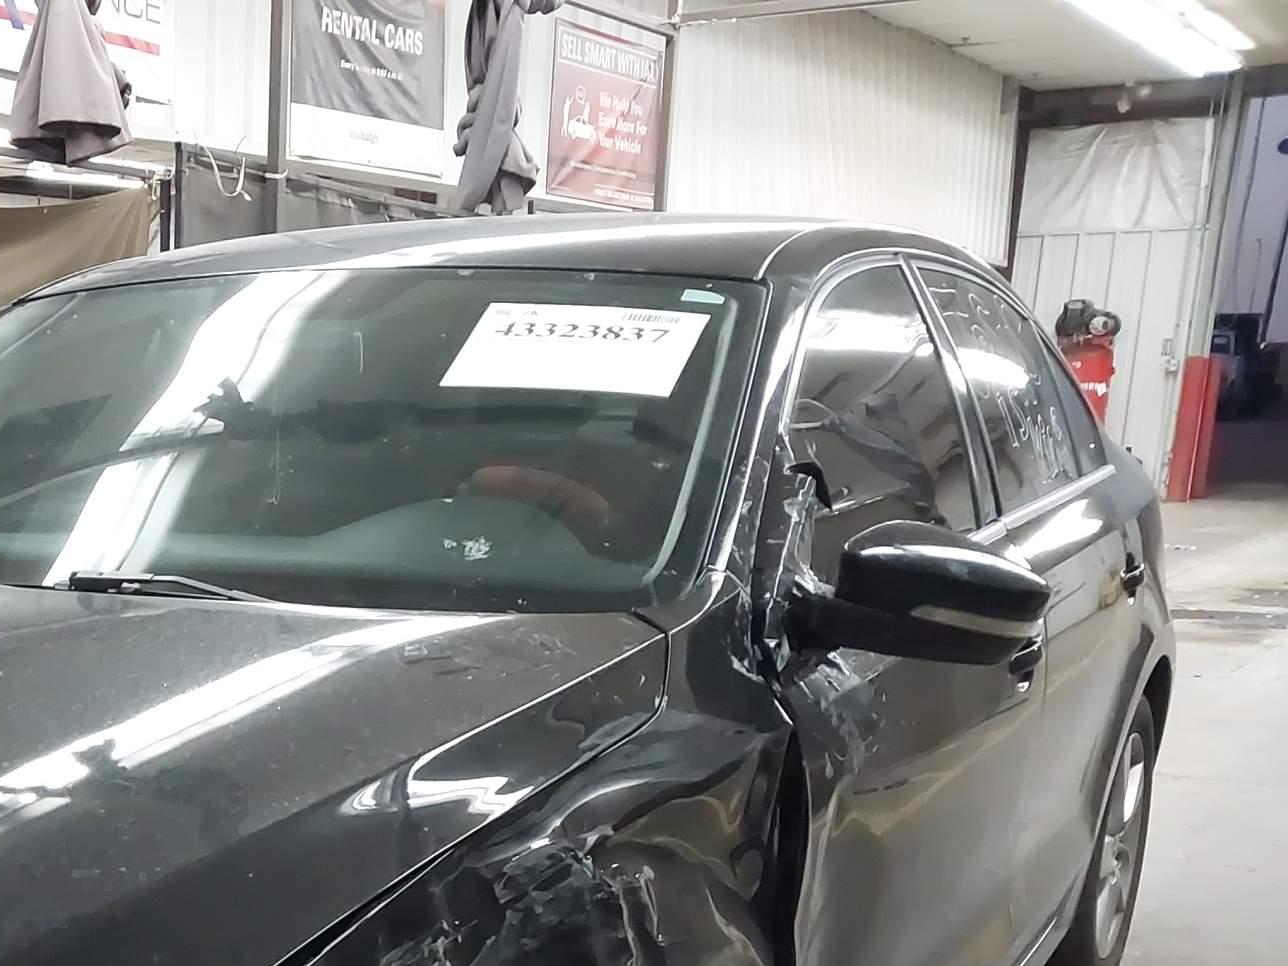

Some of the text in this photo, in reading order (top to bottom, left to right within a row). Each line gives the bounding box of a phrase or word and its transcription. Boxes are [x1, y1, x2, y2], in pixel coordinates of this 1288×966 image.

[321, 6, 423, 55] RENTAL CARS
[561, 33, 583, 62] SELL
[584, 41, 617, 71] SMART
[617, 51, 640, 80] WITH
[599, 91, 612, 108] We
[630, 100, 643, 116] You
[598, 111, 648, 136] Earn More For
[598, 129, 642, 155] Your Vehicle
[495, 321, 671, 343] 43323837
